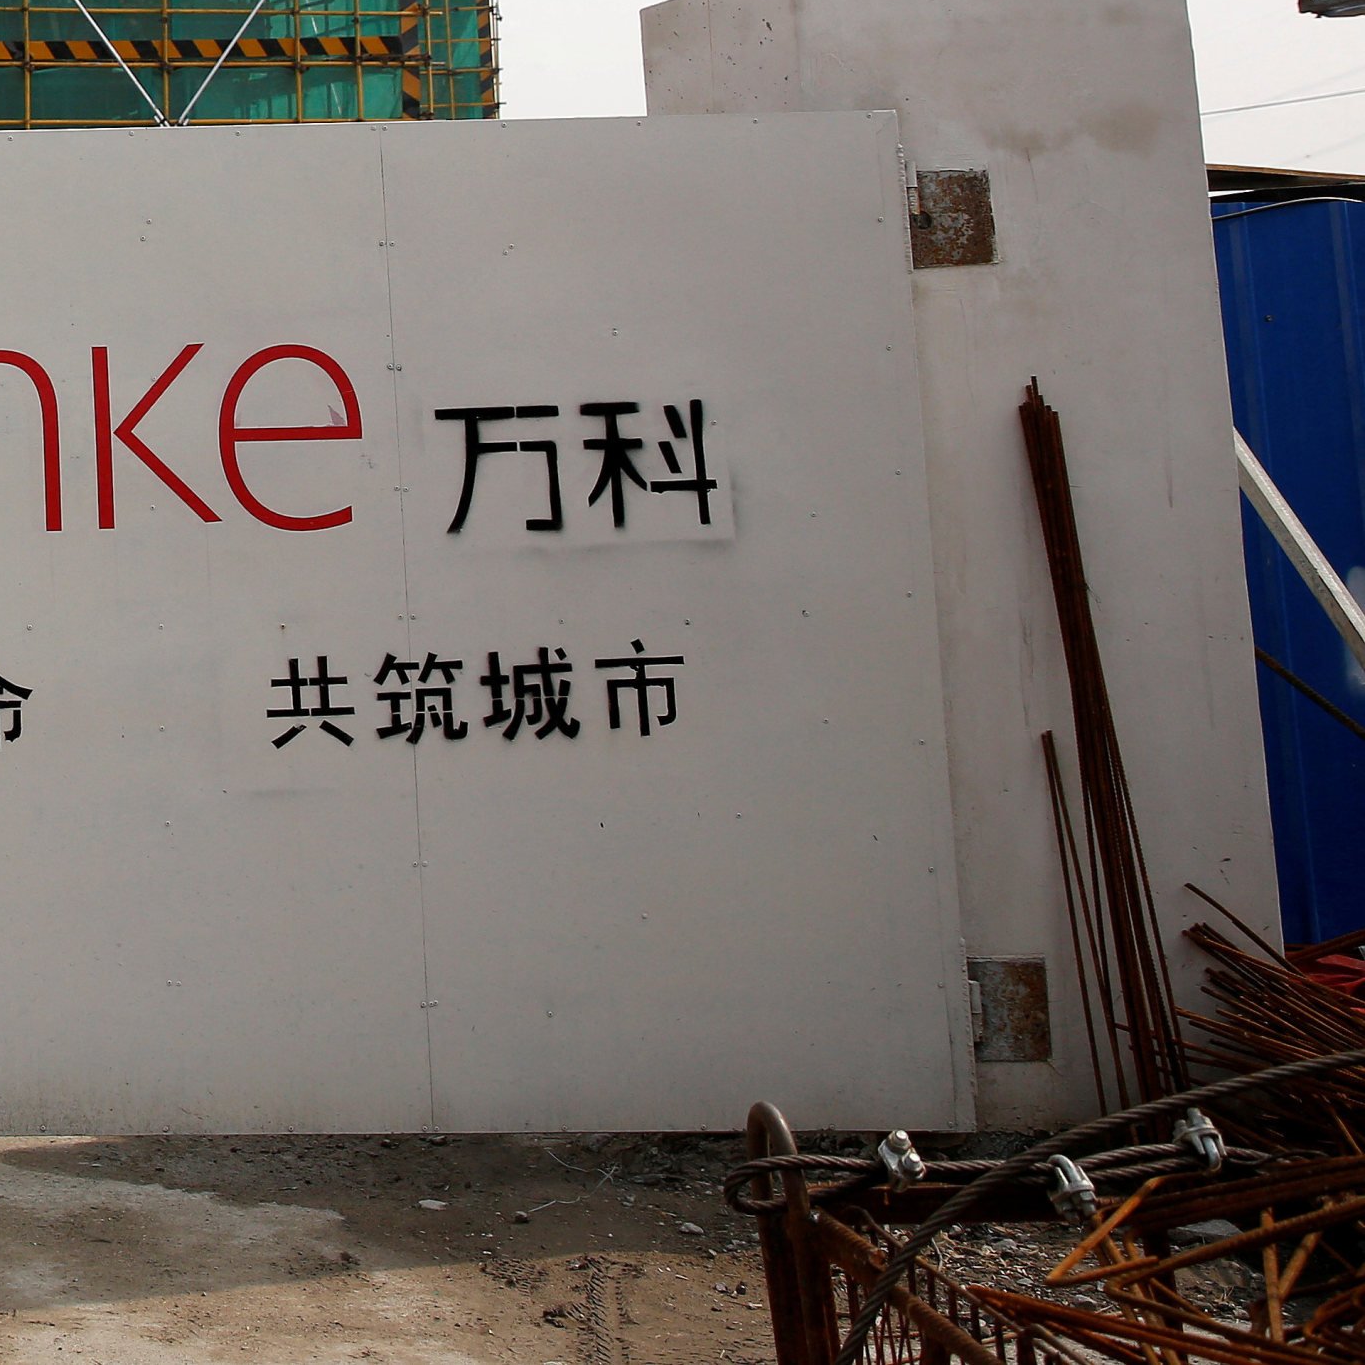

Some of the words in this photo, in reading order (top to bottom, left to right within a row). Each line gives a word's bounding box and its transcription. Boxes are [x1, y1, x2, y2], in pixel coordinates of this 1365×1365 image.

[434, 398, 718, 534] 万科
[266, 638, 685, 750] 共筑城市
